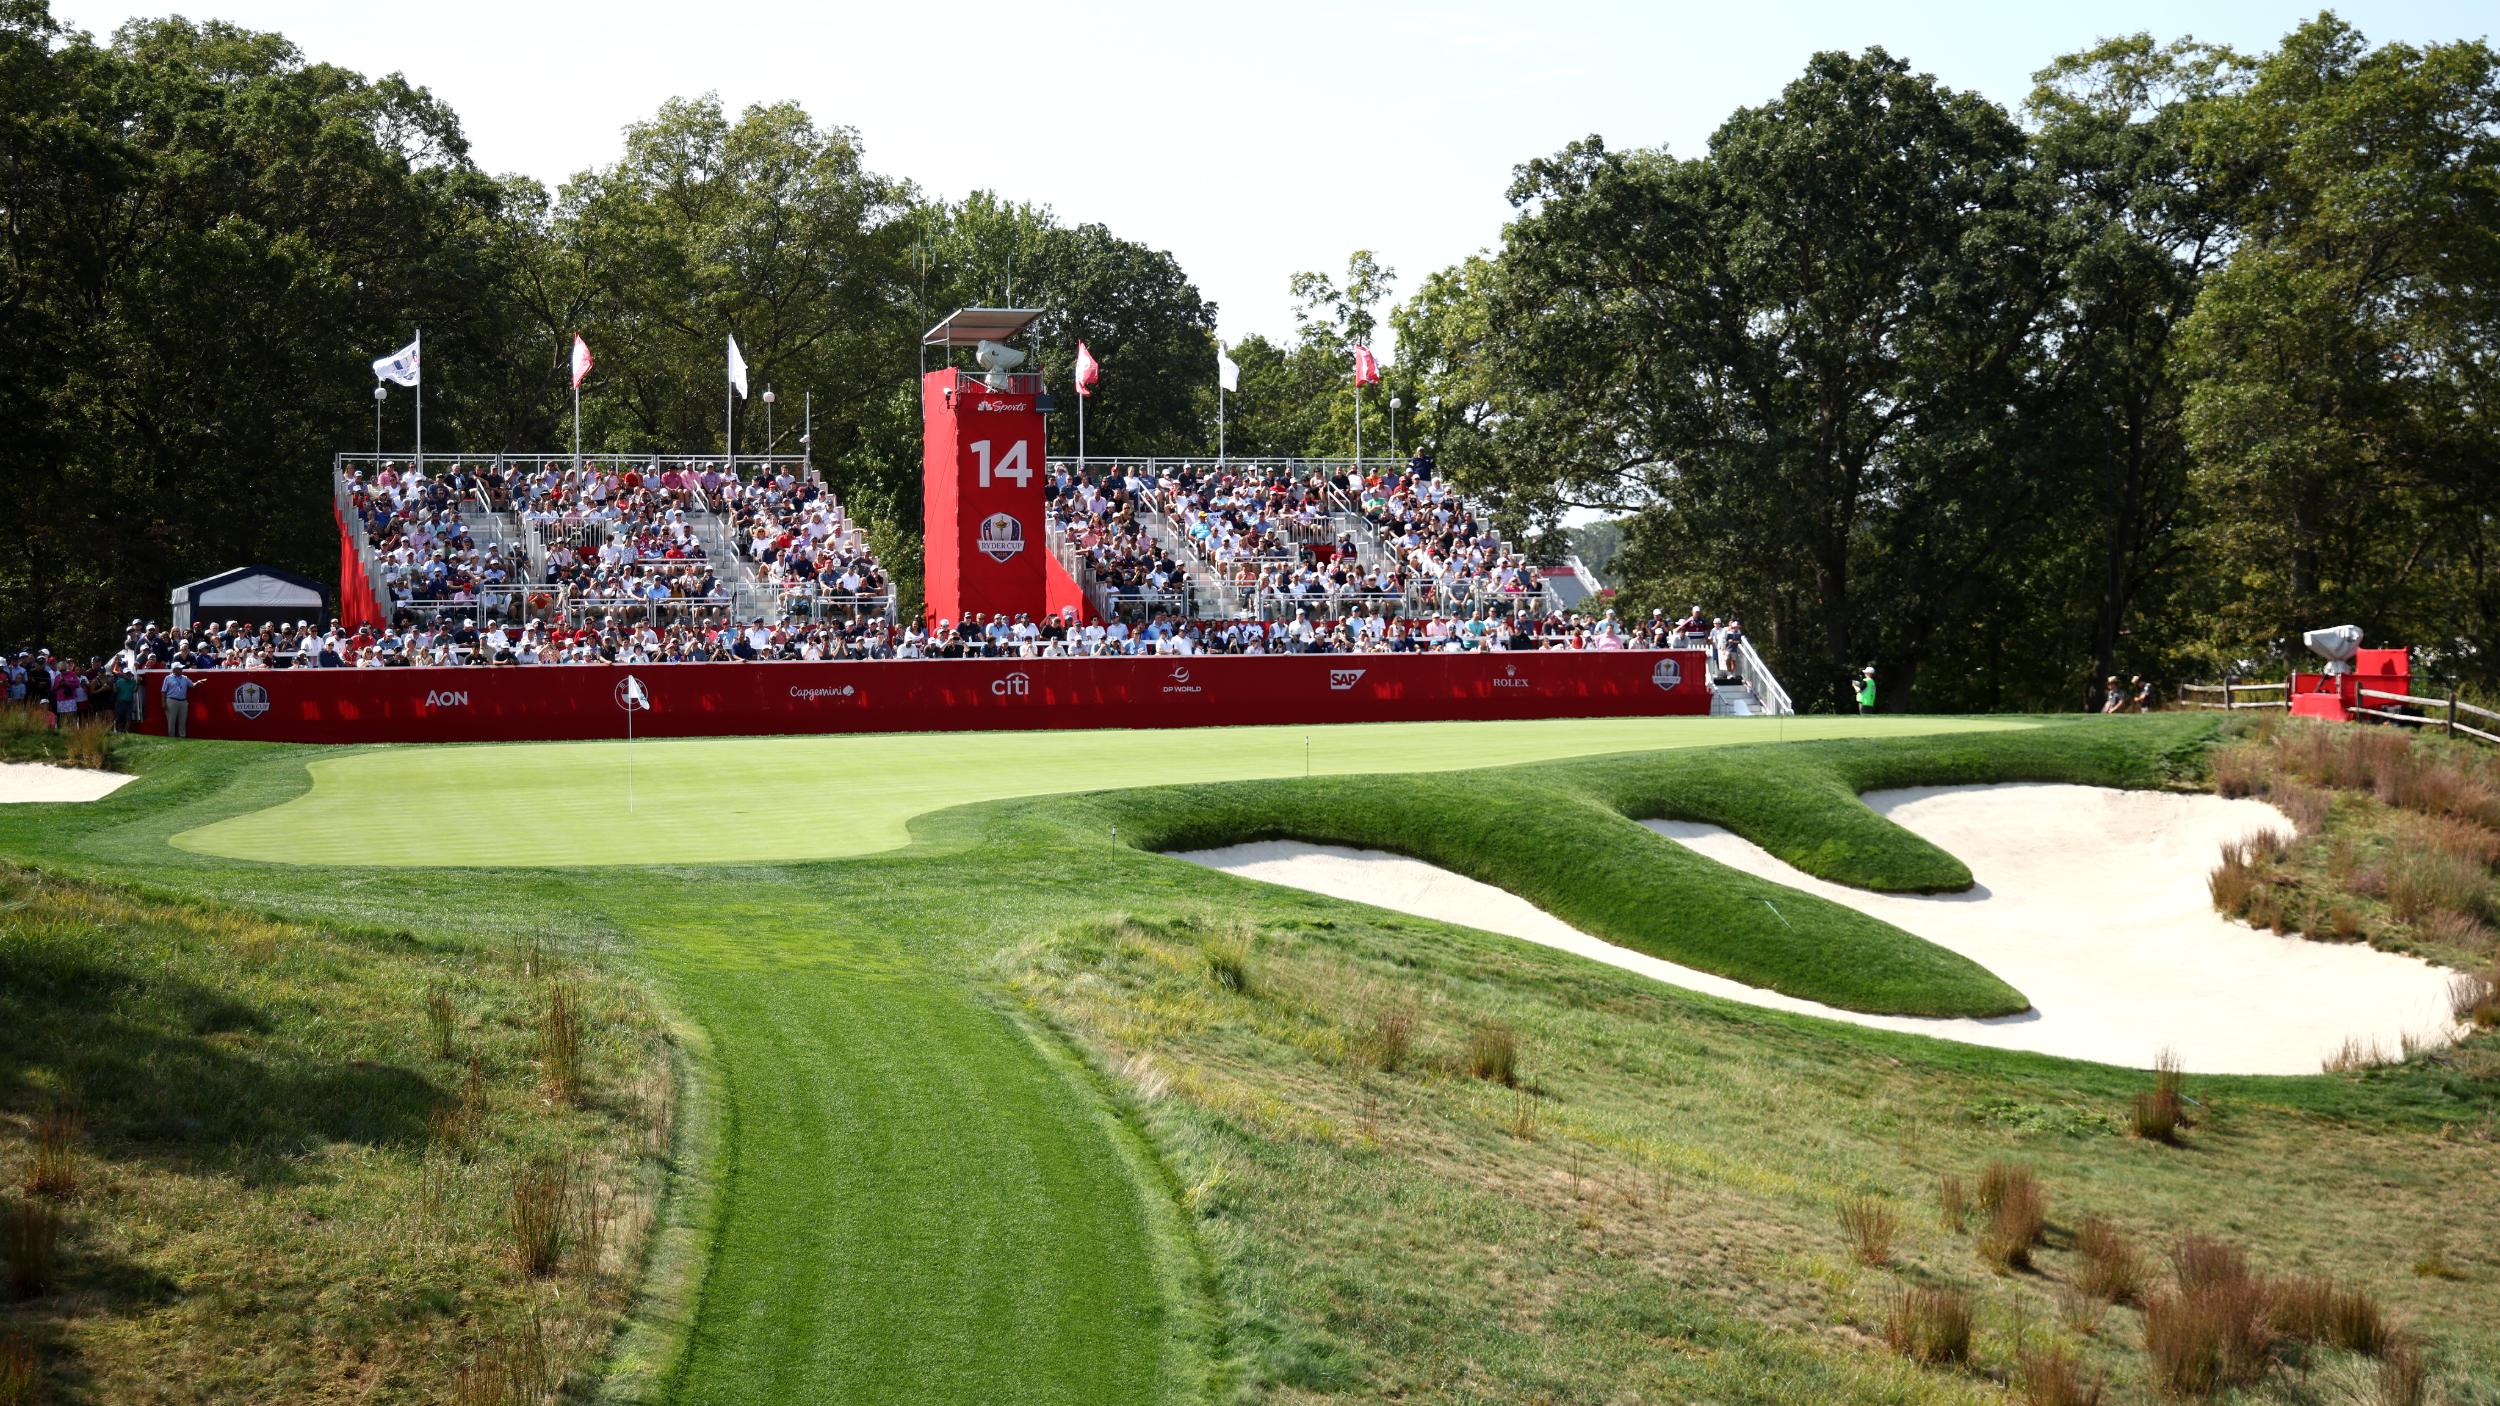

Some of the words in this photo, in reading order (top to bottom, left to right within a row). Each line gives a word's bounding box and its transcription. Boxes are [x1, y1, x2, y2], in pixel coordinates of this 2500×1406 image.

[992, 400, 1027, 413] Sports
[970, 439, 1033, 488] 14
[981, 542, 1006, 550] RYDER
[991, 672, 1030, 696] citi
[1331, 673, 1358, 686] SAP
[1493, 678, 1529, 687] ROLEX
[425, 689, 468, 706] AON
[790, 685, 842, 701] Capgemini
